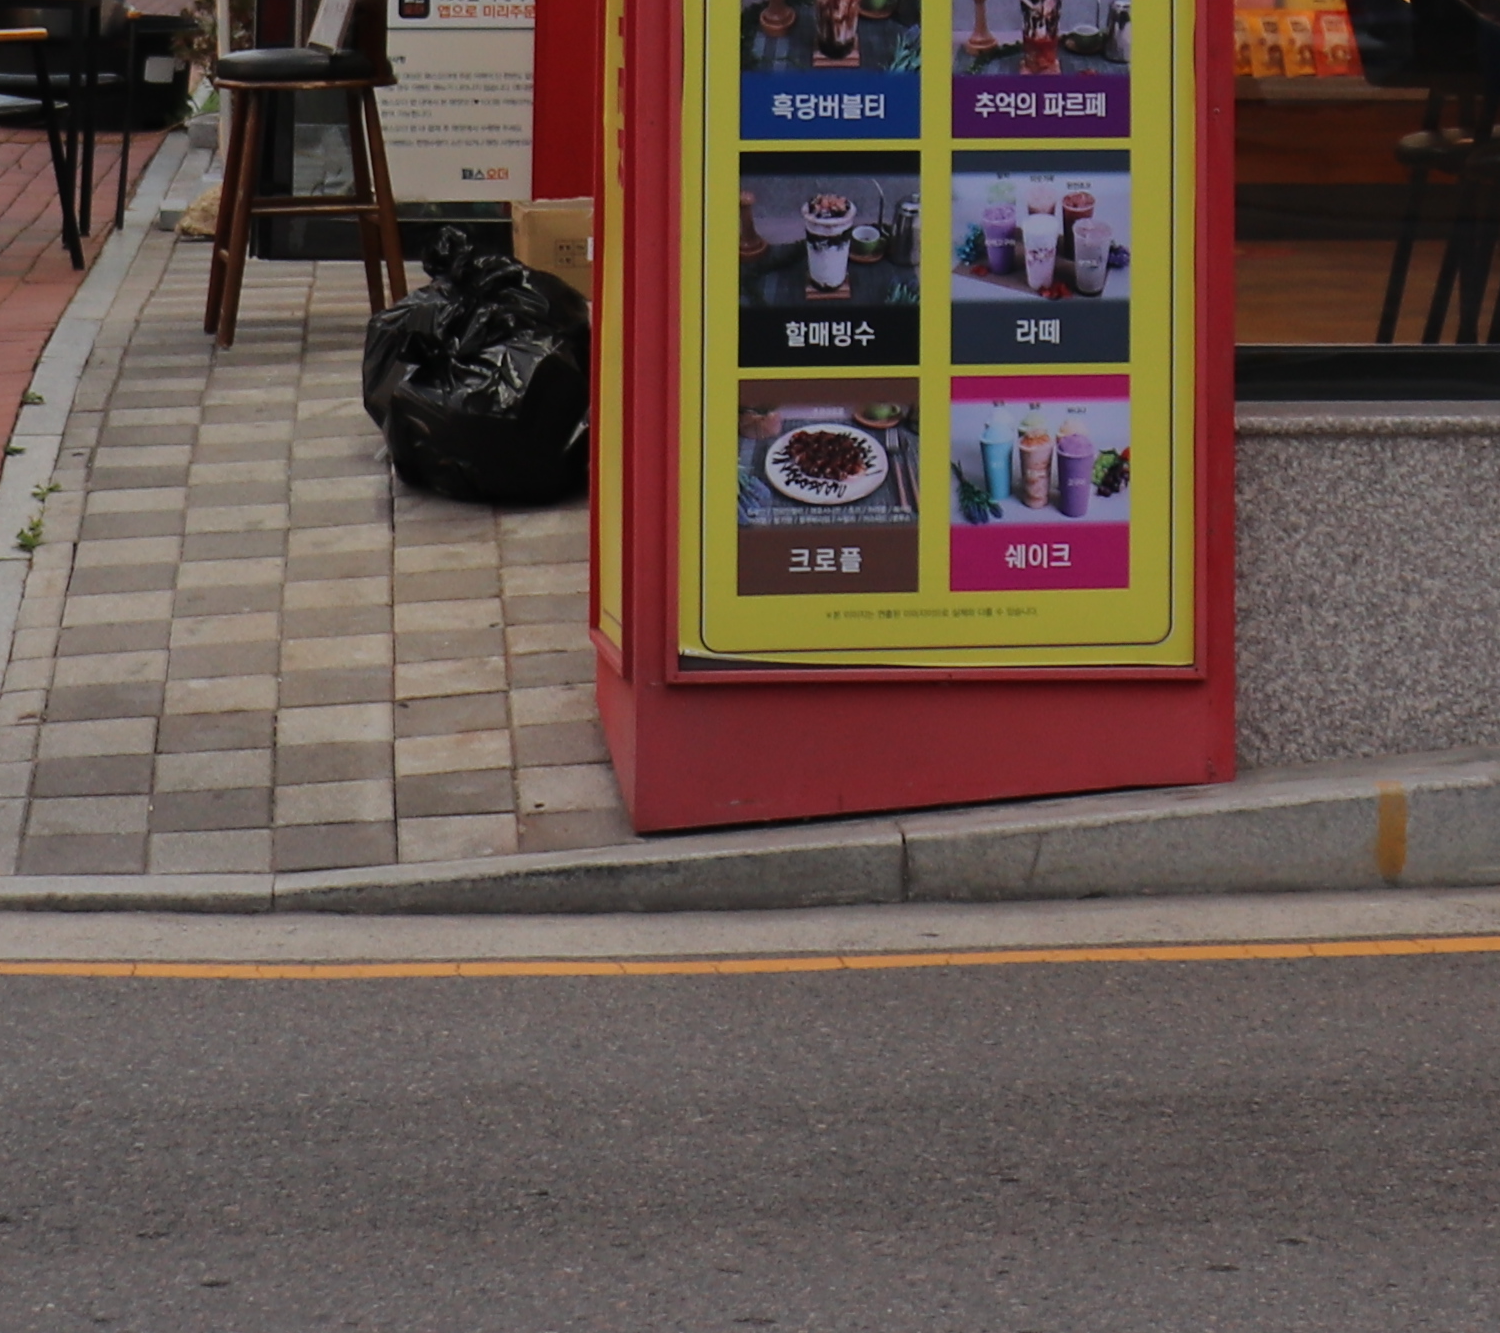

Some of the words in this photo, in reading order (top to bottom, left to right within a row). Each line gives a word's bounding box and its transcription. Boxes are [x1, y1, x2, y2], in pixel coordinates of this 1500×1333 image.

[438, 5, 478, 18] 앱으로
[770, 92, 886, 120] 흑당버블티
[974, 91, 1037, 119] 추억의
[1043, 91, 1107, 118] 파르페
[785, 320, 876, 347] 할매빙수
[1015, 318, 1061, 345] 라떼
[788, 546, 862, 574] 크로플
[1004, 542, 1072, 570] 쉐이크
